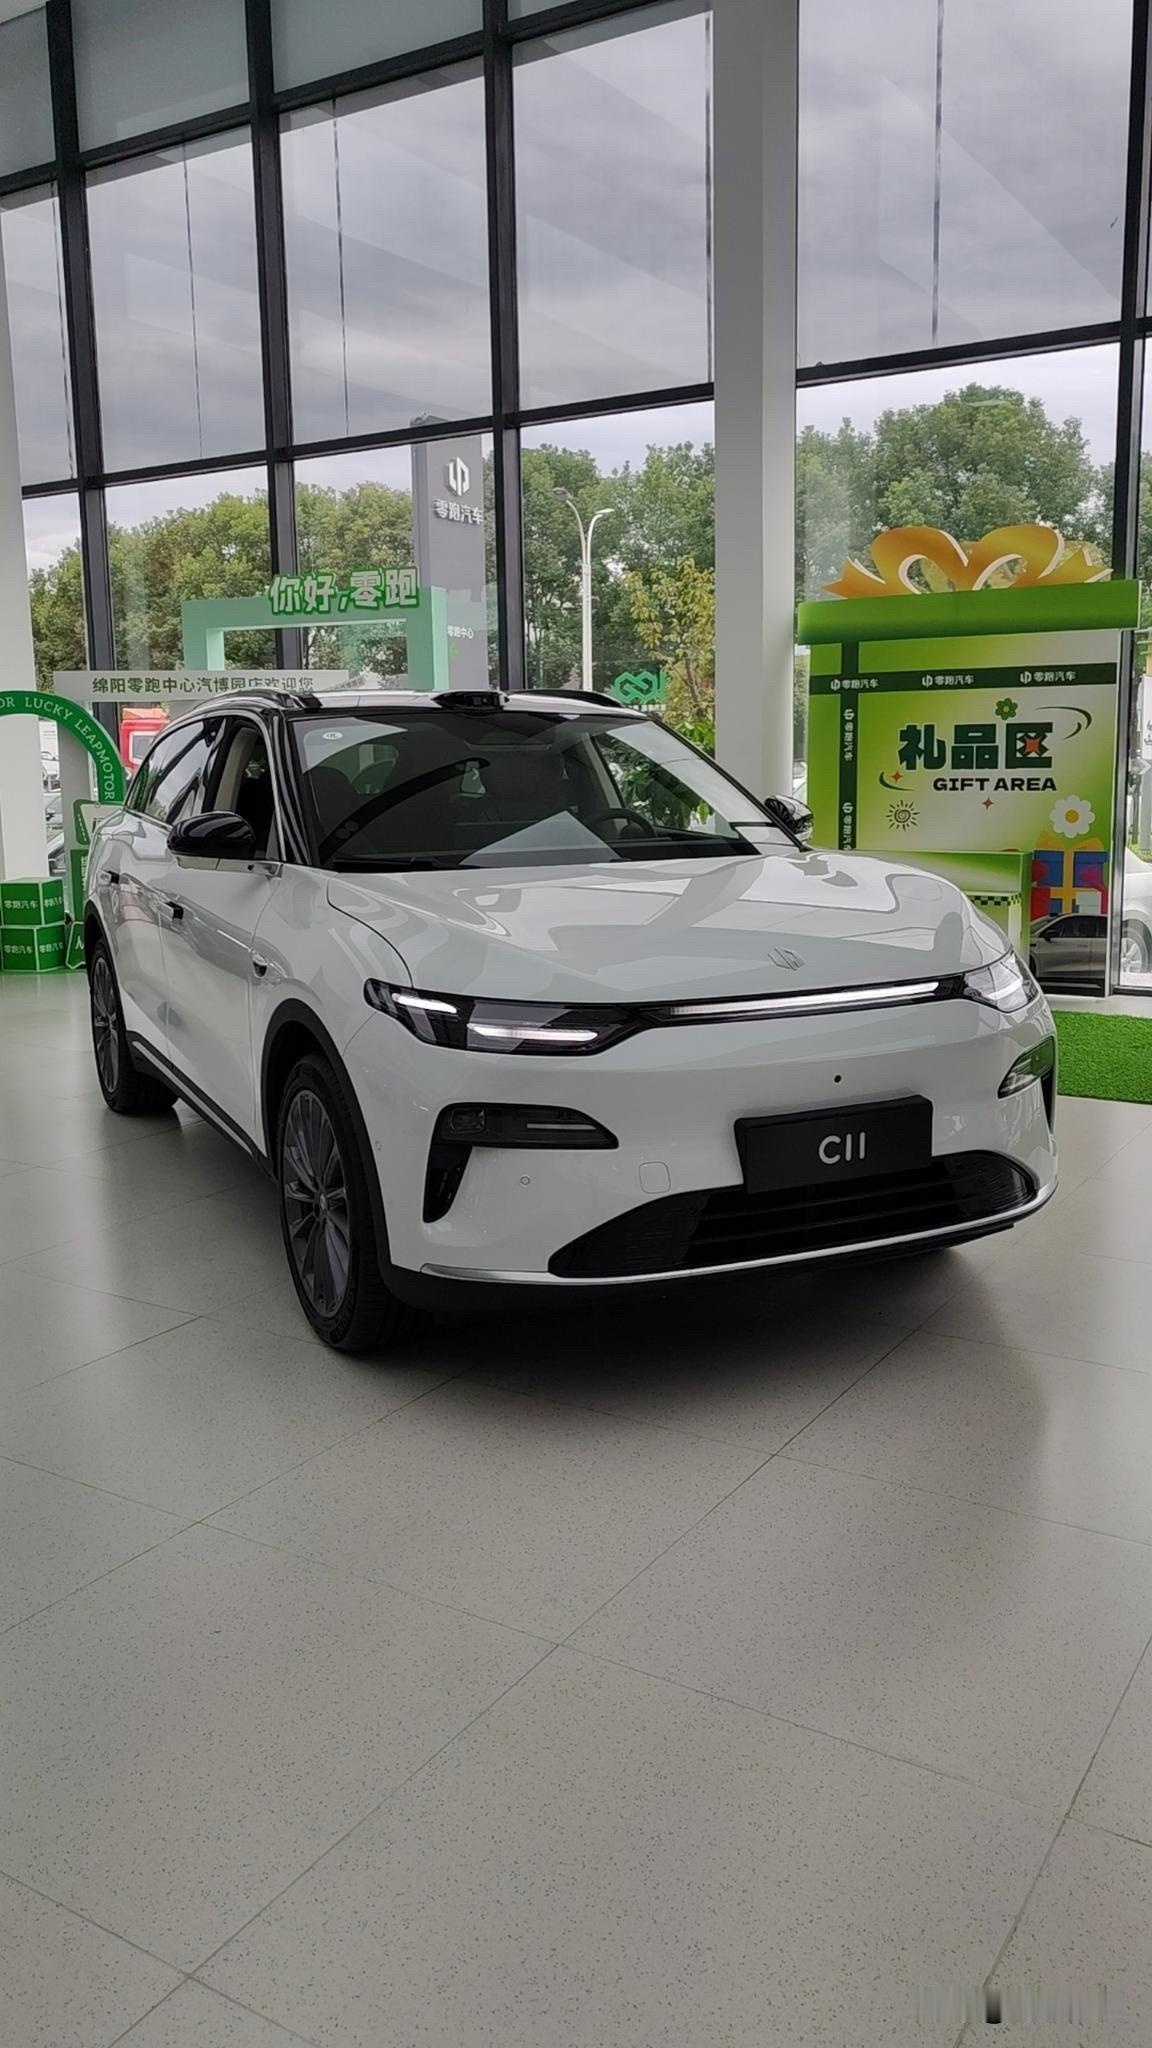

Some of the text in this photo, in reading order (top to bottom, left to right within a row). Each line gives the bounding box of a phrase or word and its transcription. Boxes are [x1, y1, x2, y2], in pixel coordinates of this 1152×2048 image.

[434, 499, 483, 525] 零跑汽车
[842, 678, 879, 689] 零跑汽车
[934, 674, 974, 686] 零跑汽车
[1033, 671, 1076, 682] 零跑汽车
[25, 697, 73, 720] LUCKY
[74, 718, 116, 800] LEAPMOTOR
[898, 722, 1053, 770] 礼品区
[933, 777, 1057, 792] GIFT AREA
